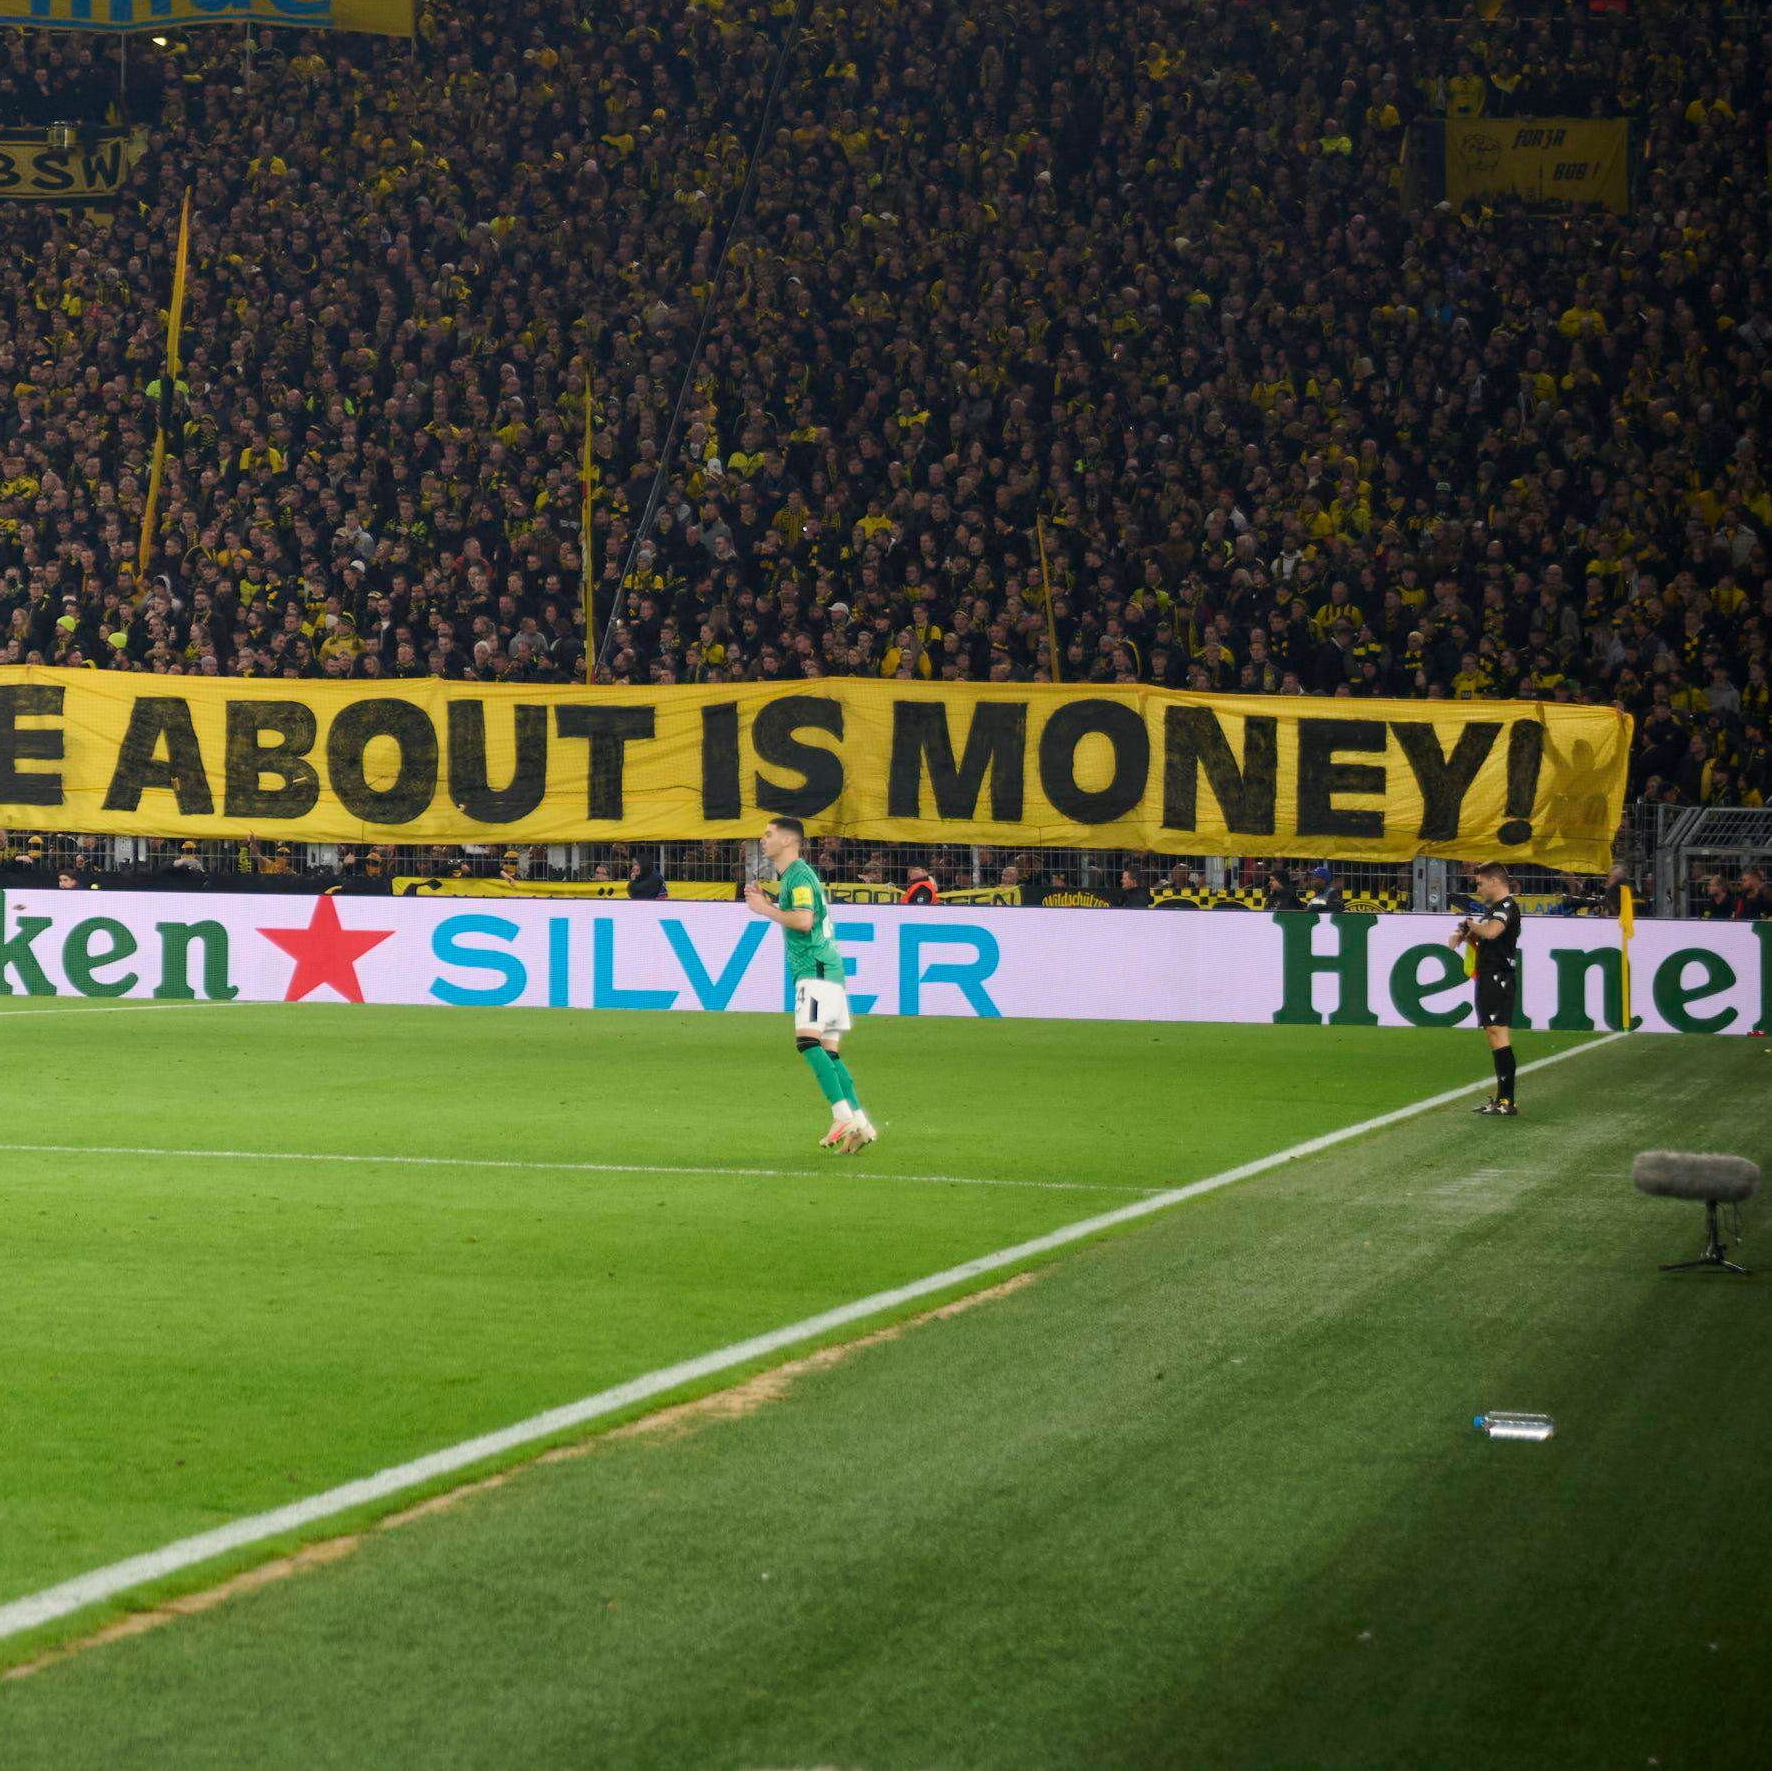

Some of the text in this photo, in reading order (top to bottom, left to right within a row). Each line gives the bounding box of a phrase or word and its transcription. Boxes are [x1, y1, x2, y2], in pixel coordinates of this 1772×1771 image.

[102, 695, 656, 825] ABOUT
[701, 696, 846, 823] IS
[886, 699, 1546, 846] MONEY!
[1273, 911, 1772, 1036] Hene
